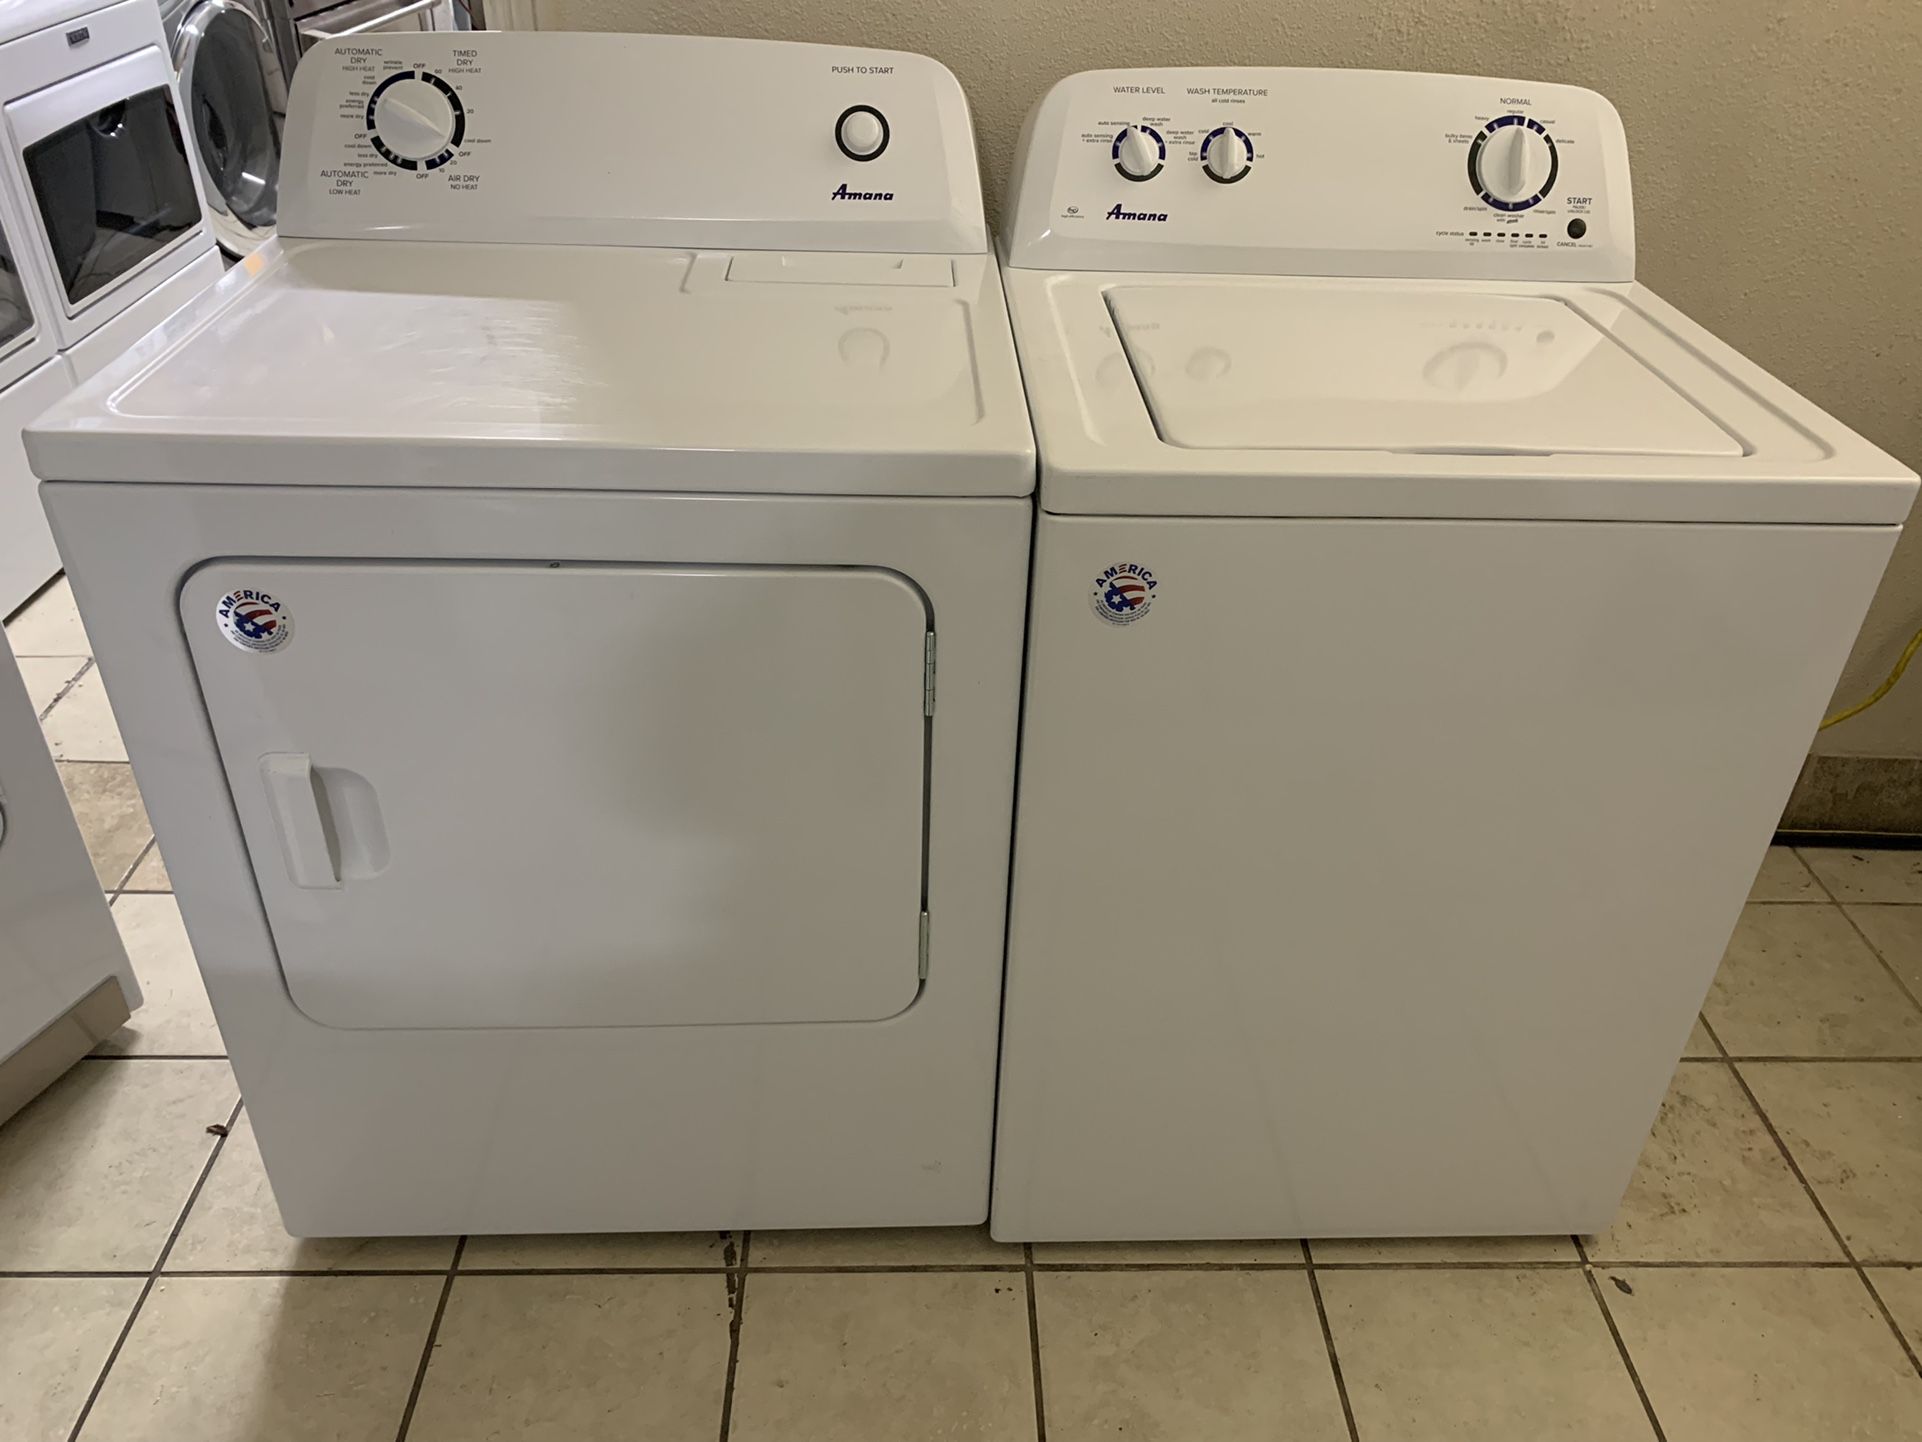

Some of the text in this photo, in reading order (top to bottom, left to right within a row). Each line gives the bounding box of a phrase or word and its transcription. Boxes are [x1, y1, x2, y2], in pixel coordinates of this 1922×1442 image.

[334, 48, 383, 56] AUTOMATIC
[452, 50, 478, 58] TIMED
[856, 66, 867, 74] TO
[1113, 86, 1140, 94] WATER
[1212, 88, 1268, 96] TEMPERATURE
[1500, 98, 1532, 106] NORMAL
[320, 170, 369, 178] AUTOMATIC
[831, 183, 894, 200] Amana
[1106, 203, 1168, 221] Amana
[1096, 563, 1157, 590] AMERICA
[219, 590, 281, 618] AMERICA
